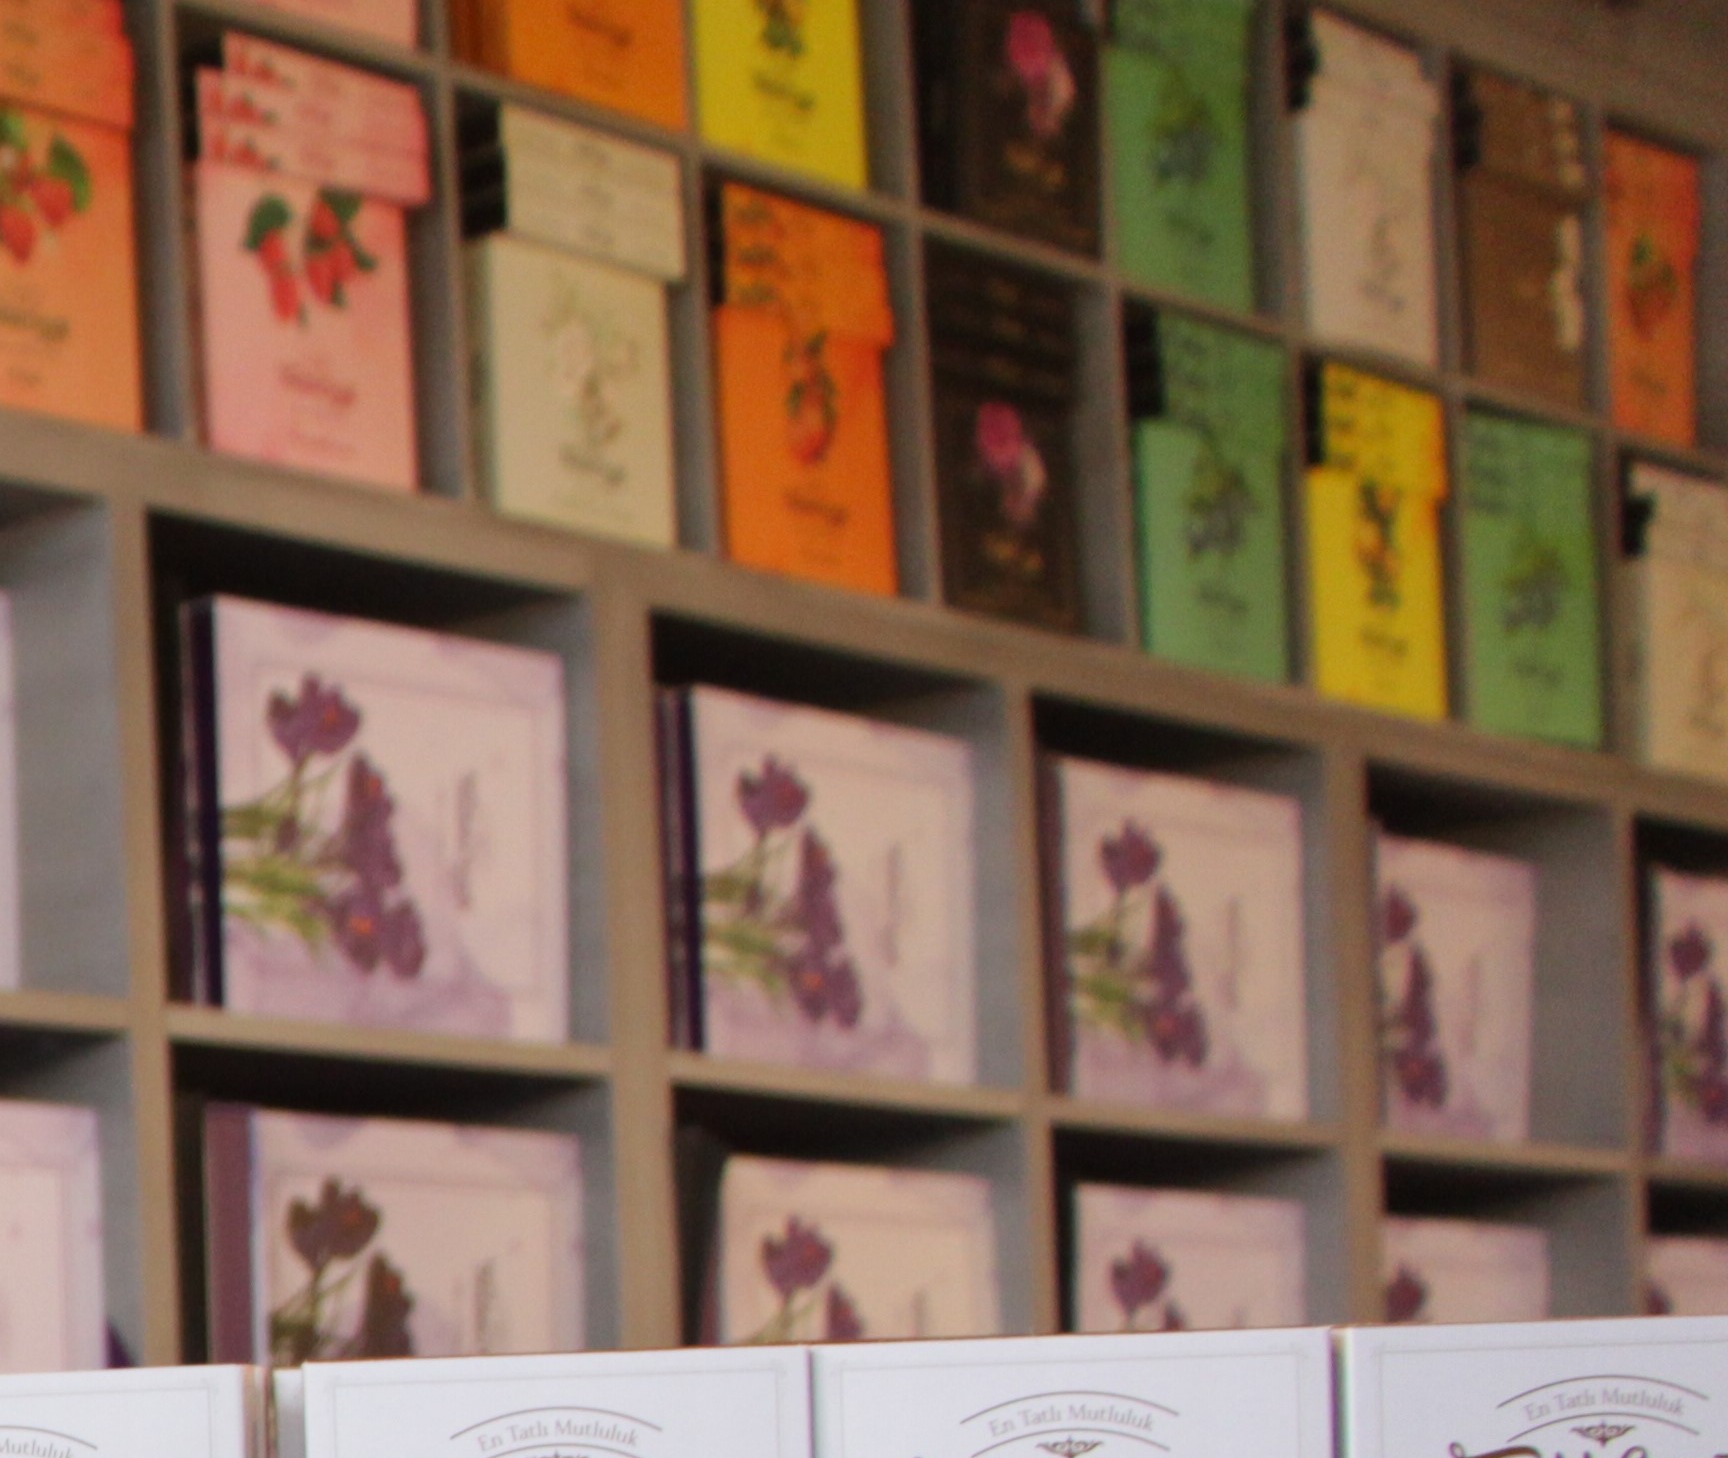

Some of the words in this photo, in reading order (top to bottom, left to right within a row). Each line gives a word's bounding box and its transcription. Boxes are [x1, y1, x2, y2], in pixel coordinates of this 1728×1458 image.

[989, 1417, 1015, 1438] En
[1018, 1404, 1063, 1429] Tatlı
[1068, 1403, 1155, 1433] Mutluluk
[1523, 1403, 1551, 1422] En
[1600, 1387, 1684, 1417] Mutluluk
[477, 1432, 502, 1452] En
[506, 1419, 549, 1445] Tatlı
[554, 1418, 639, 1448] Mutluluk
